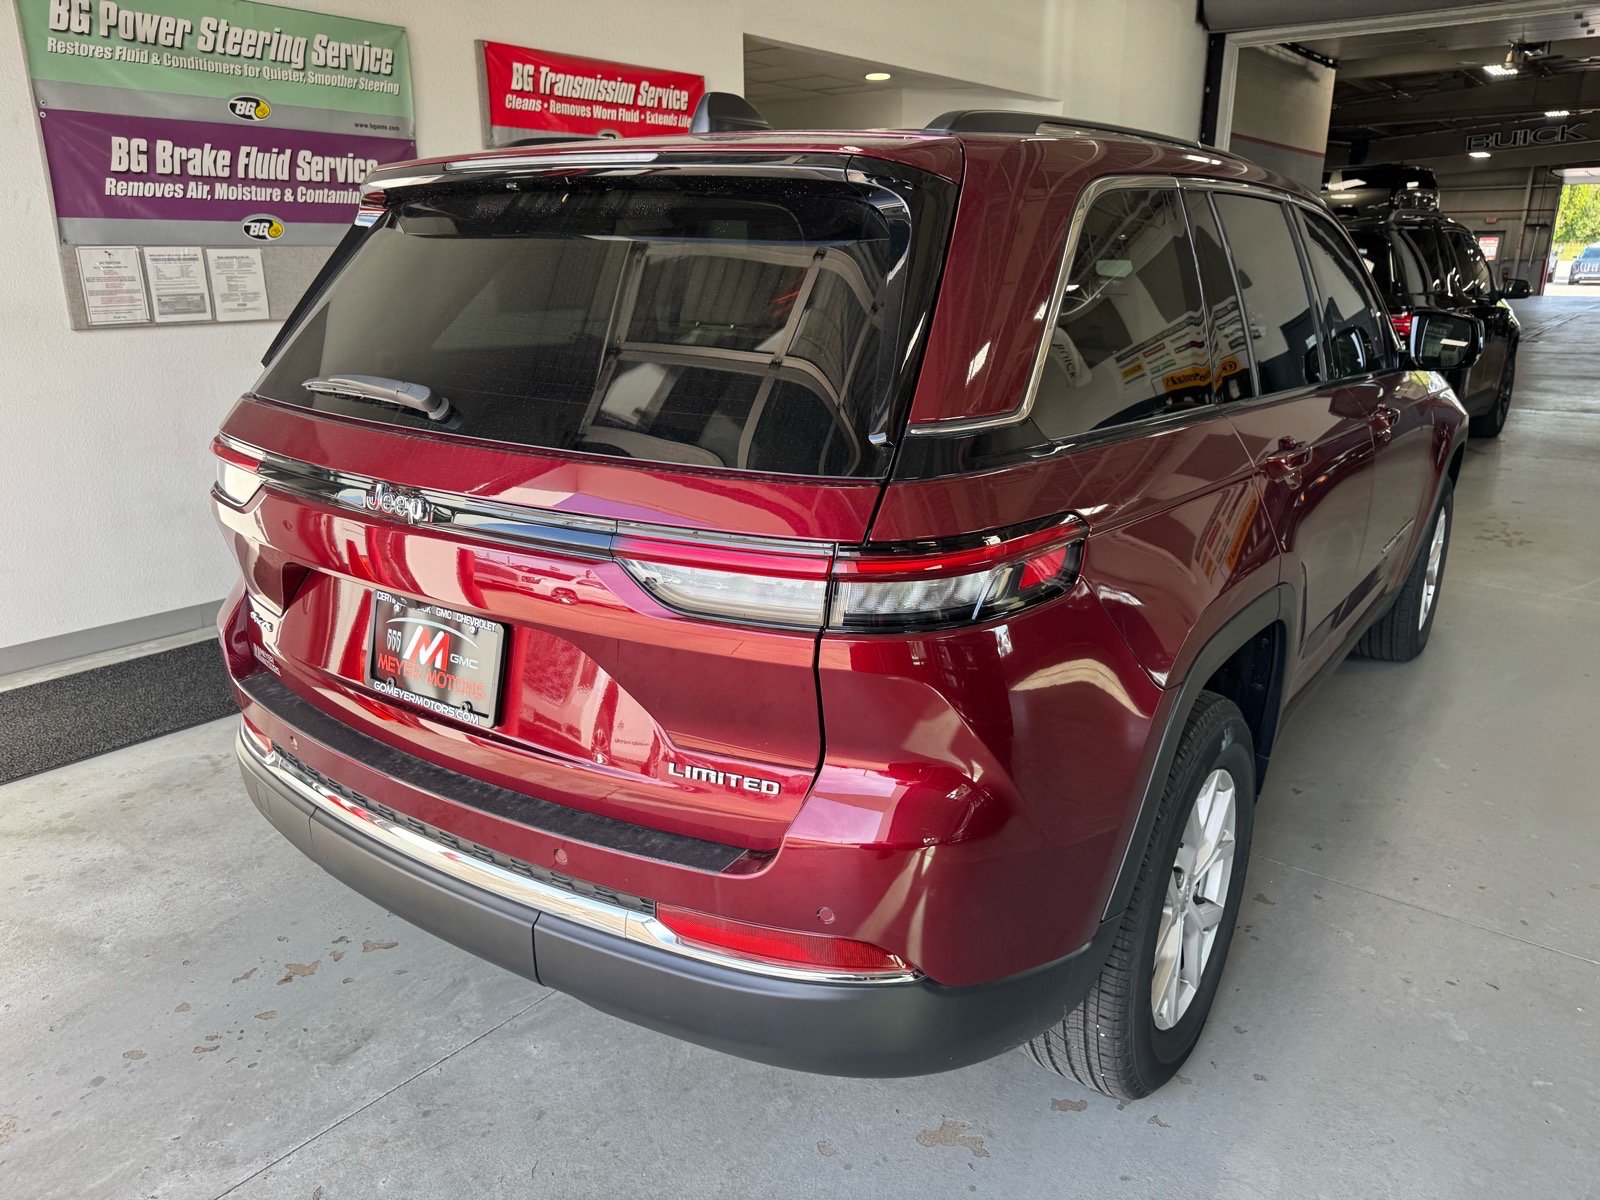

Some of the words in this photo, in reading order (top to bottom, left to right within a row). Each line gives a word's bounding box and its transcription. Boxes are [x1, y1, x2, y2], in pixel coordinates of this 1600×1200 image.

[49, 0, 91, 35] BG
[99, 1, 192, 48] Power
[197, 16, 308, 69] Steering
[311, 33, 393, 75] Service
[47, 37, 112, 60] Restores
[115, 45, 149, 64] Fluid
[151, 52, 161, 66] &
[163, 52, 242, 76] Conditioners
[243, 65, 261, 78] for
[263, 66, 306, 84] Quieter,
[307, 71, 358, 89] Smoother
[359, 78, 400, 95] Steering
[511, 62, 535, 92] BG
[539, 66, 636, 106] Transmission
[637, 80, 689, 111] Service
[505, 94, 542, 112] Cleans
[549, 99, 591, 118] Removes
[592, 105, 617, 120] Worn
[618, 105, 640, 123] Fluid
[646, 111, 678, 127] Extends
[1466, 122, 1590, 152] BUICK
[110, 136, 148, 173] BG
[156, 139, 231, 178] Brake
[237, 146, 292, 181] Fluid
[105, 177, 184, 198] Removes
[186, 181, 211, 201] Air,
[214, 182, 281, 202] Moisture
[284, 187, 294, 202] &
[297, 186, 360, 205] Contamin
[366, 483, 424, 524] Jeep
[435, 608, 452, 620] GMC
[456, 613, 497, 632] CHEVROLET
[378, 653, 422, 681] MEYER
[425, 669, 485, 700] MOTORS
[450, 654, 479, 670] GMC
[374, 681, 480, 725] GOMEYERMOTORS.COM
[668, 762, 781, 795] LIMITED
